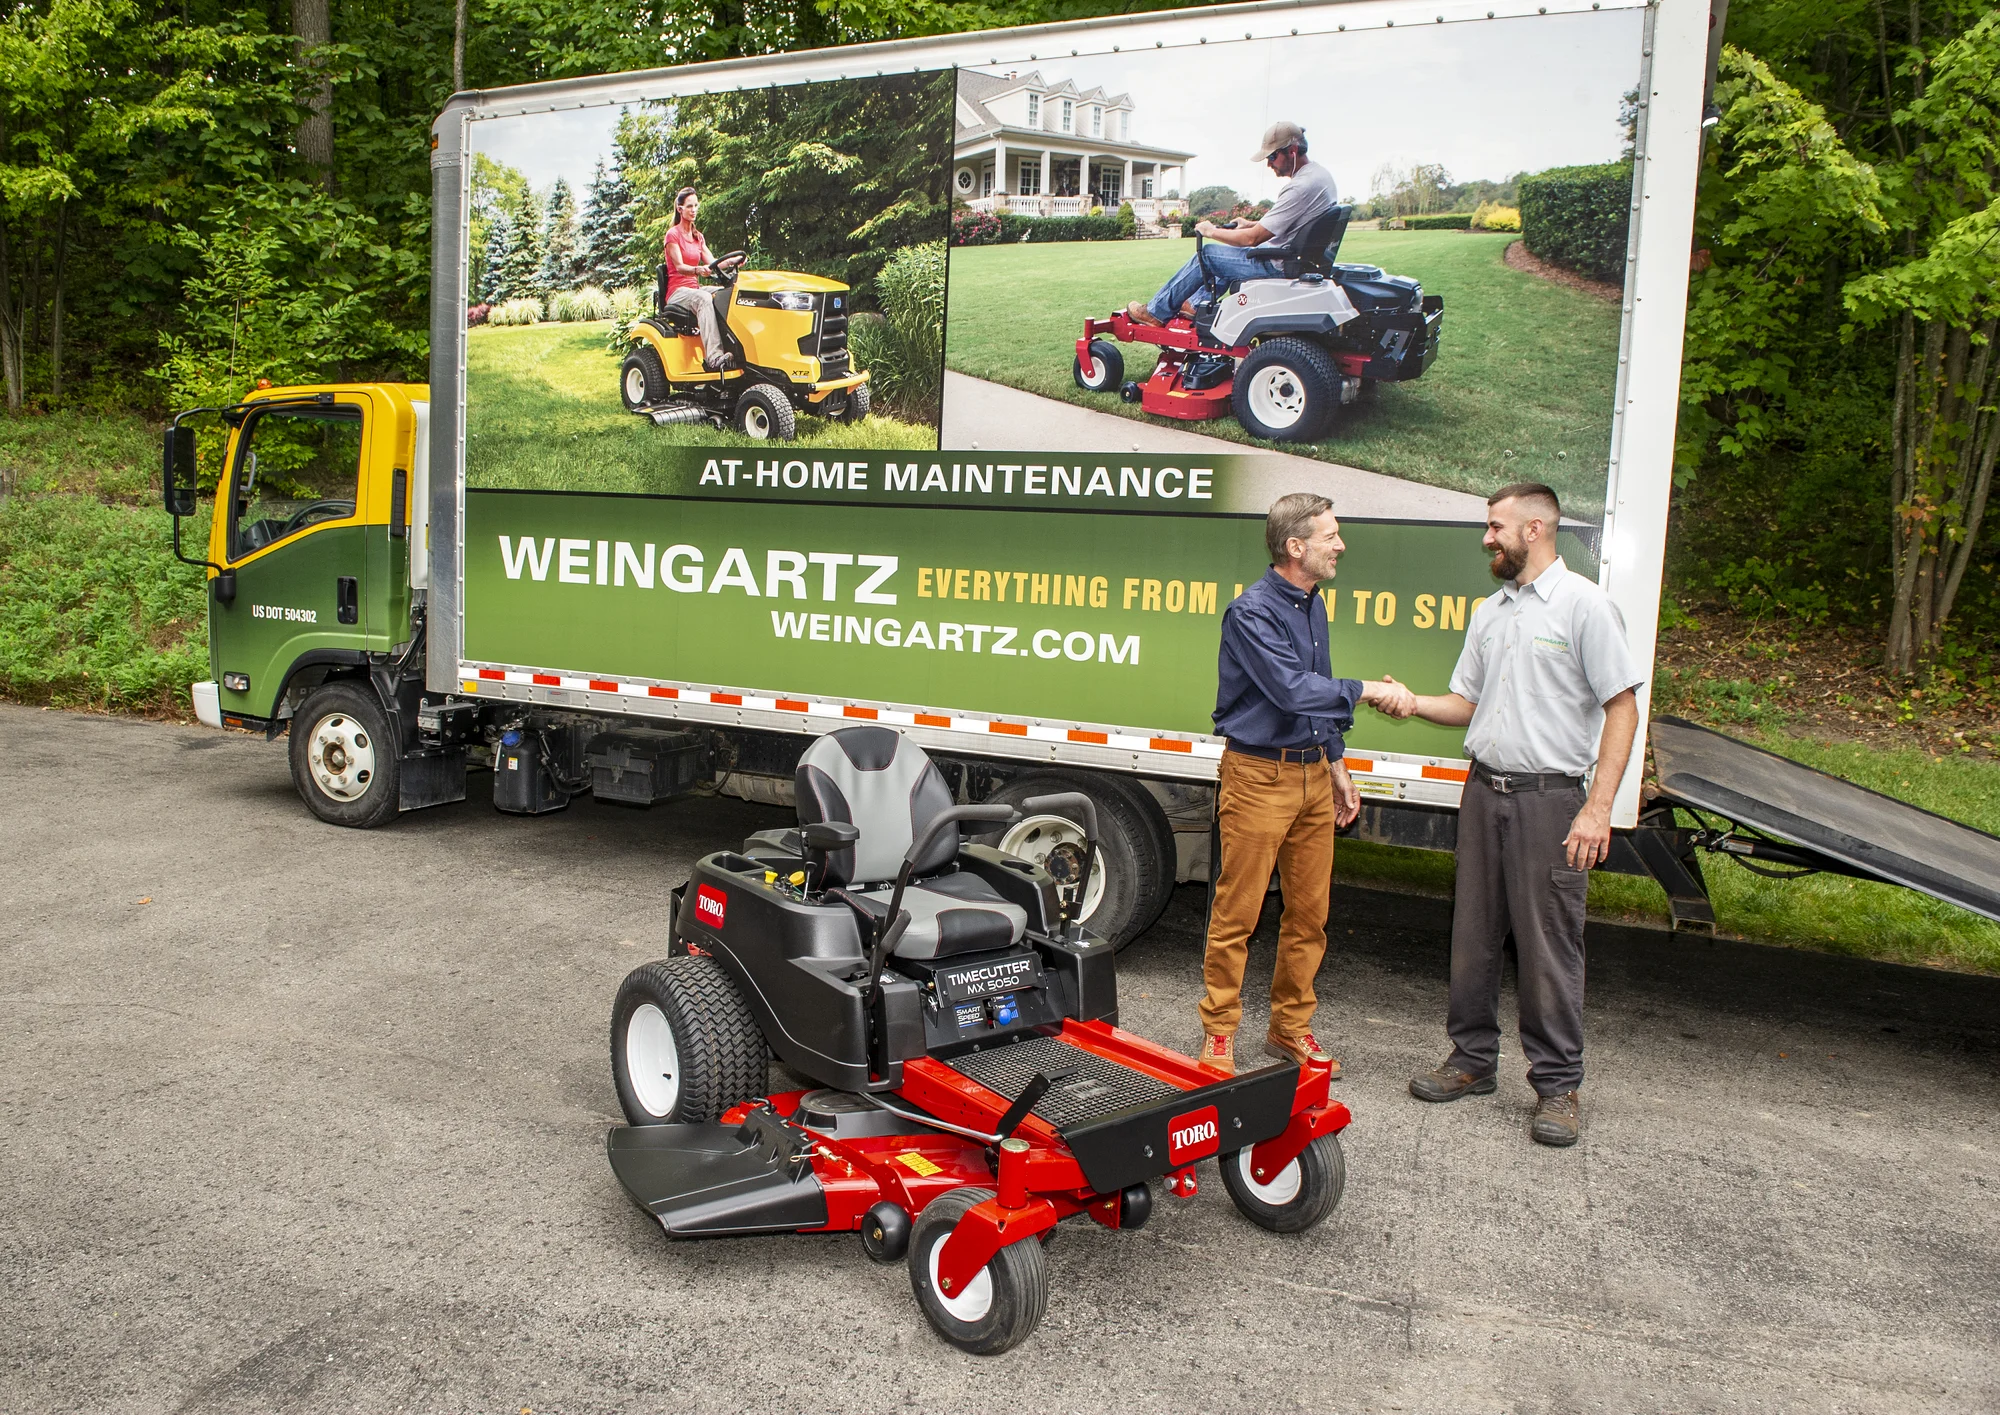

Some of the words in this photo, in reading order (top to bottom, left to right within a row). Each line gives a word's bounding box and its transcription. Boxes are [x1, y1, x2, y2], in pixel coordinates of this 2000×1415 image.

[698, 459, 868, 490] AT-HOME
[884, 463, 1214, 499] MAINTENANCE
[498, 535, 899, 606] WEINGARTZ
[917, 567, 1109, 609] EVERYTHING
[1123, 577, 1218, 615] FROM
[1353, 590, 1397, 627] TO
[252, 604, 265, 618] US
[265, 605, 284, 620] DOT
[284, 608, 317, 623] 504302
[770, 610, 1141, 666] WEINGARTZ.COM
[948, 959, 1031, 986] TIMECUTTER
[967, 982, 986, 995] MX
[987, 975, 1020, 992] 5050
[956, 1005, 981, 1017] SMART
[957, 1012, 981, 1022] SPEED
